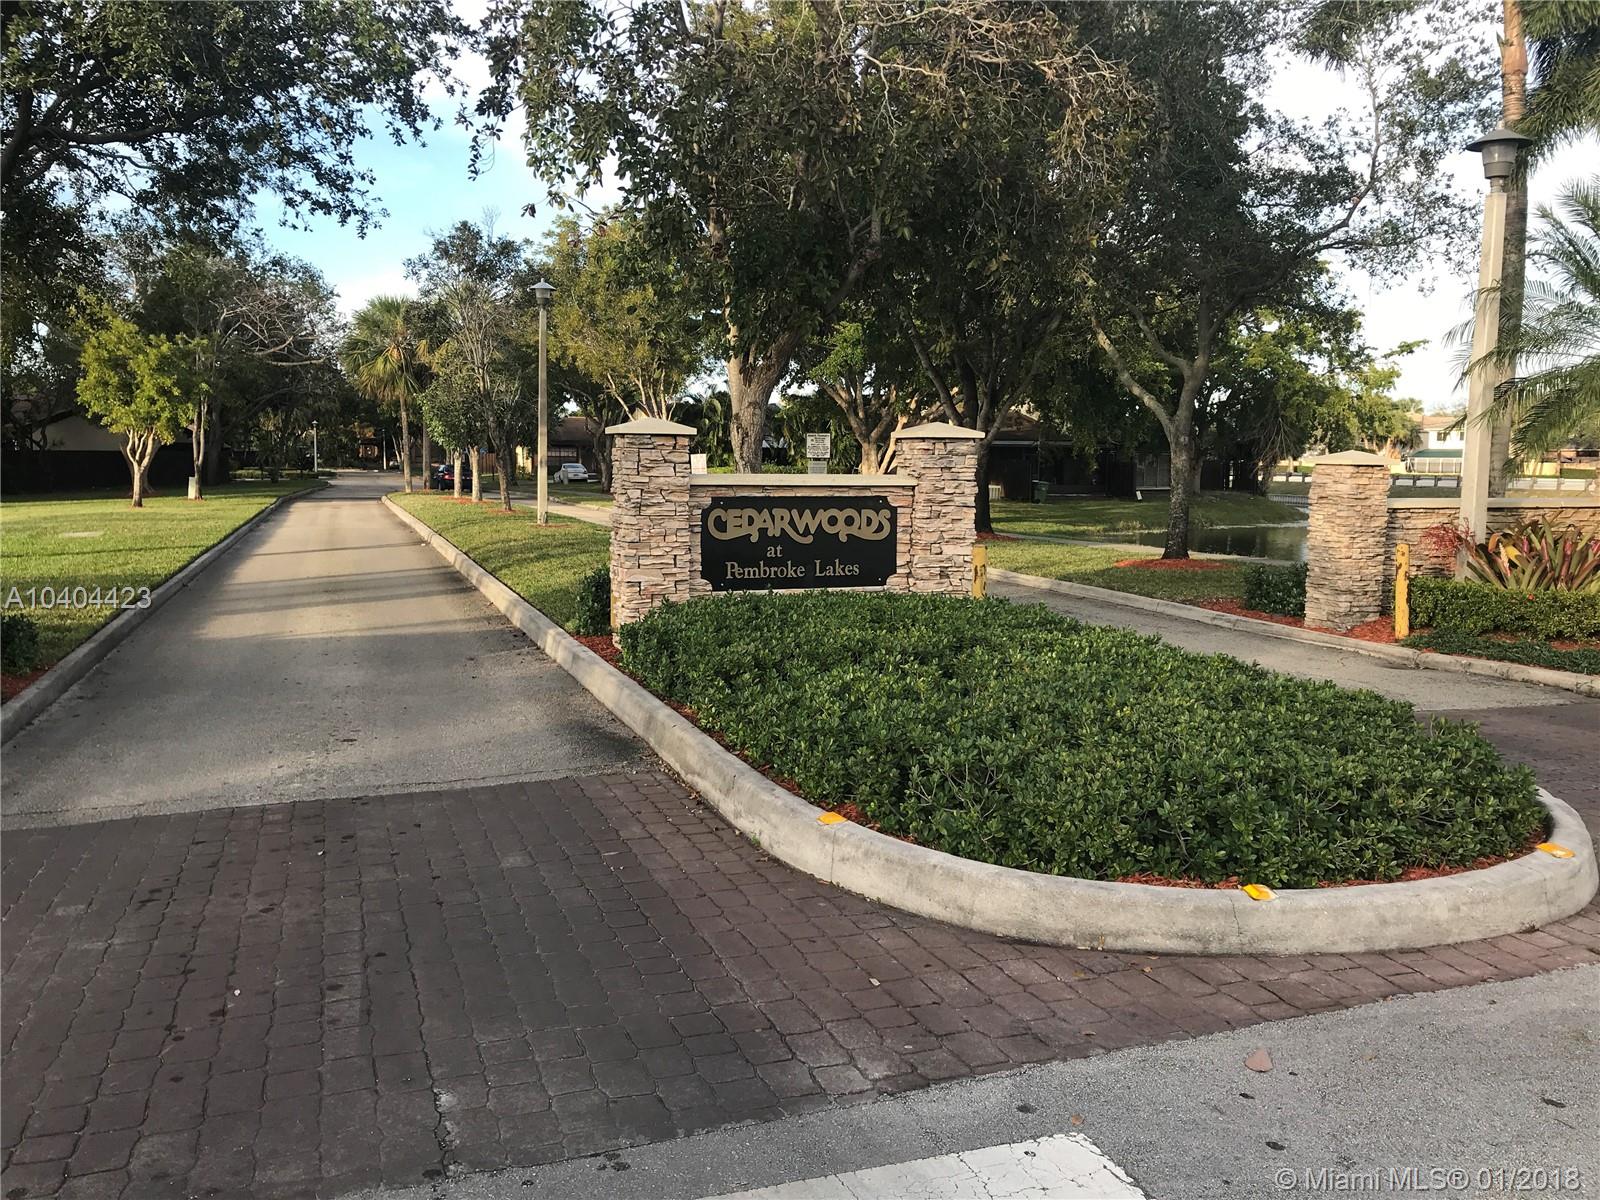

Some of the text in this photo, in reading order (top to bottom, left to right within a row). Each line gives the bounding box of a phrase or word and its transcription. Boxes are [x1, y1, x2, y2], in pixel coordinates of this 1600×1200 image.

[707, 507, 892, 544] CEDARWOODS
[766, 544, 783, 558] at
[725, 558, 860, 579] Pembroke Lakes
